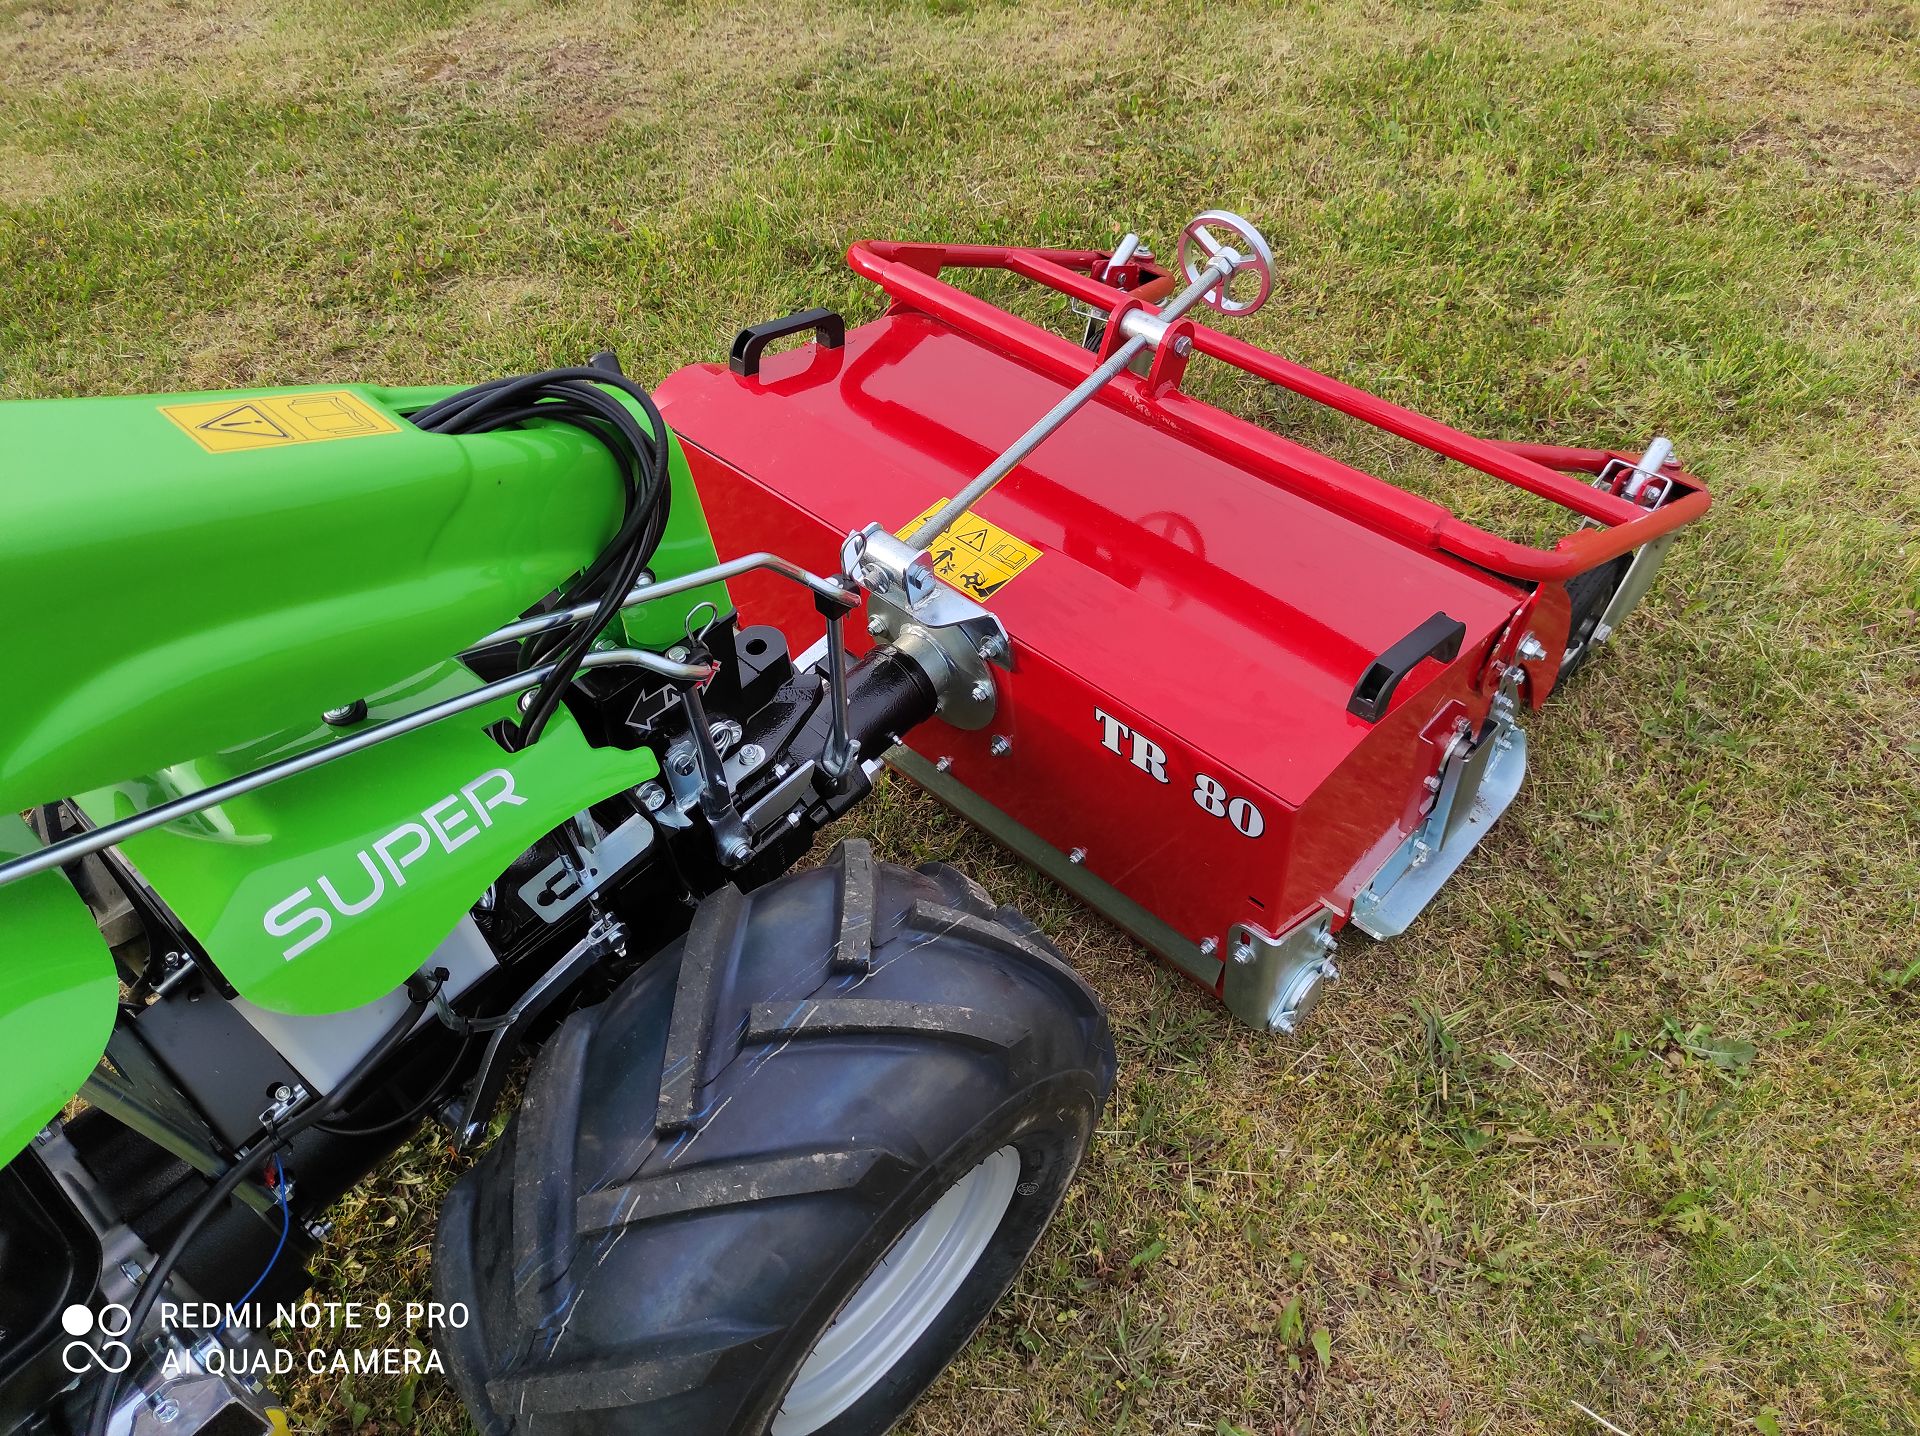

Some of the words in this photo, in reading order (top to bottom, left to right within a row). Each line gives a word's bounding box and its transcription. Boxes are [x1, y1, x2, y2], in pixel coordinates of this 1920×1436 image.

[1093, 706, 1171, 785] TR
[1191, 771, 1266, 840] 80
[264, 769, 528, 961] SUPER
